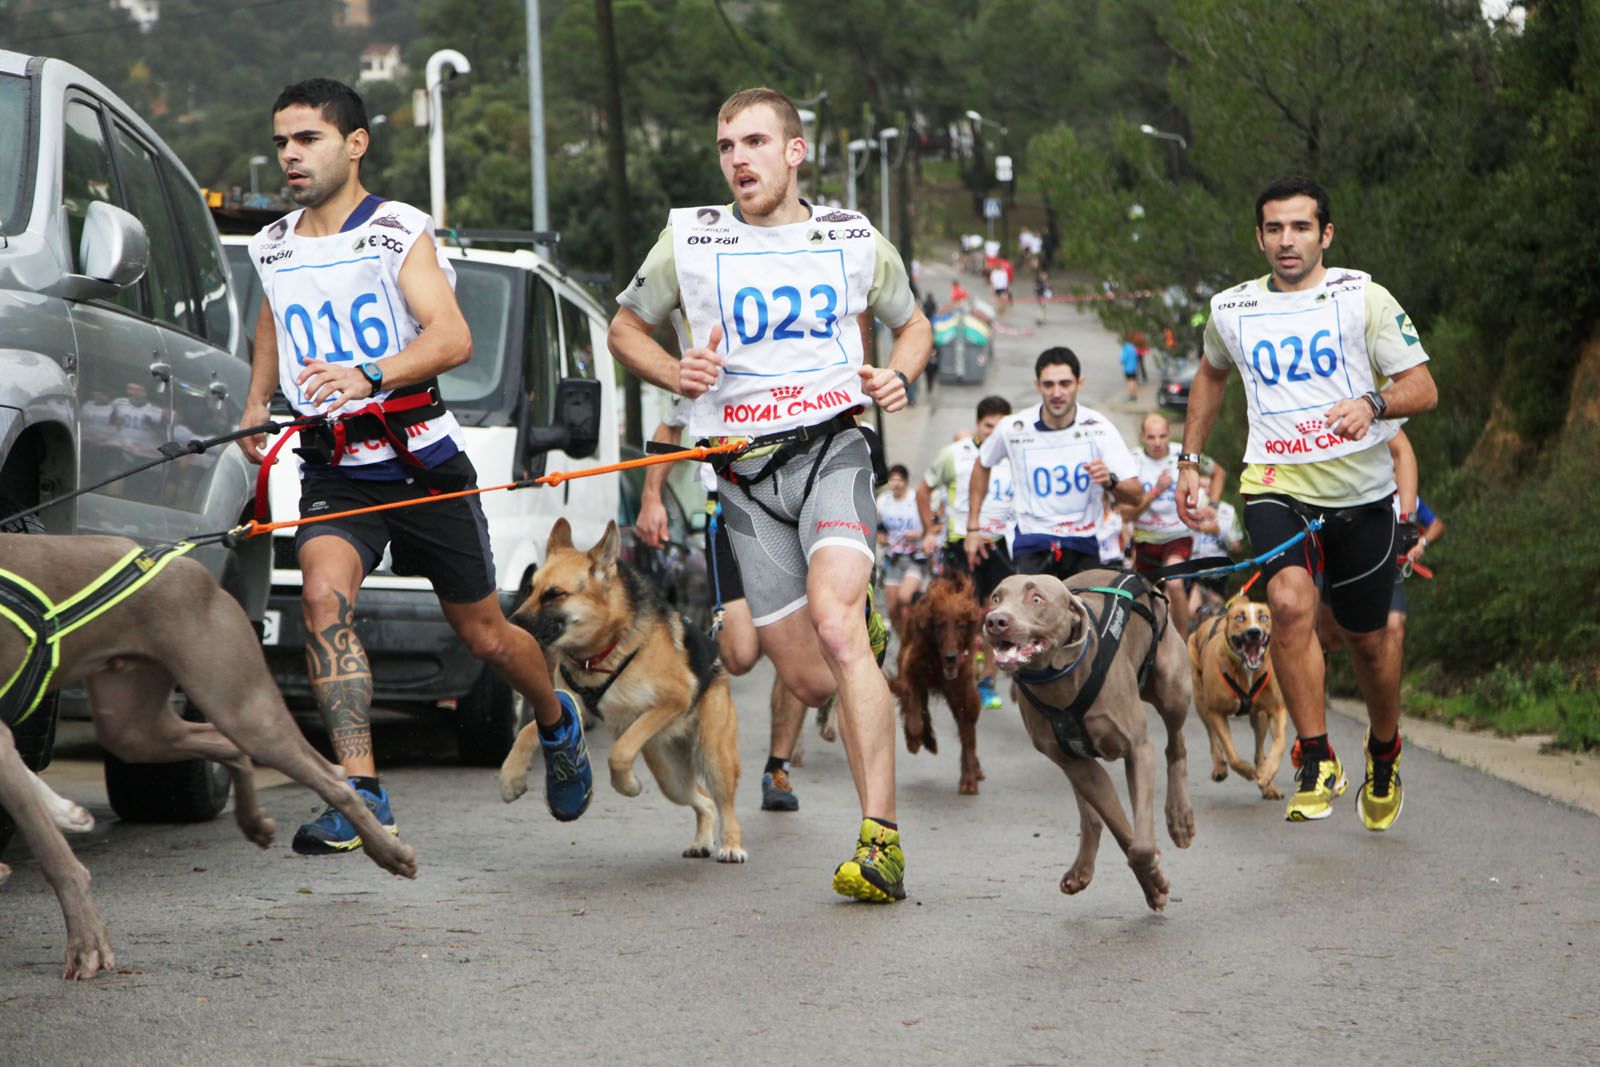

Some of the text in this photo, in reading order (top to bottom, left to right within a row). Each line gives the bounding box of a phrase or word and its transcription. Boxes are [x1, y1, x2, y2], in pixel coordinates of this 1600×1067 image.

[284, 292, 390, 368] 016
[733, 284, 837, 346] 023
[1252, 329, 1338, 386] 026
[723, 389, 853, 424] ROYAL CANIN
[1265, 437, 1313, 455] ROYAL
[1033, 461, 1091, 498] 036
